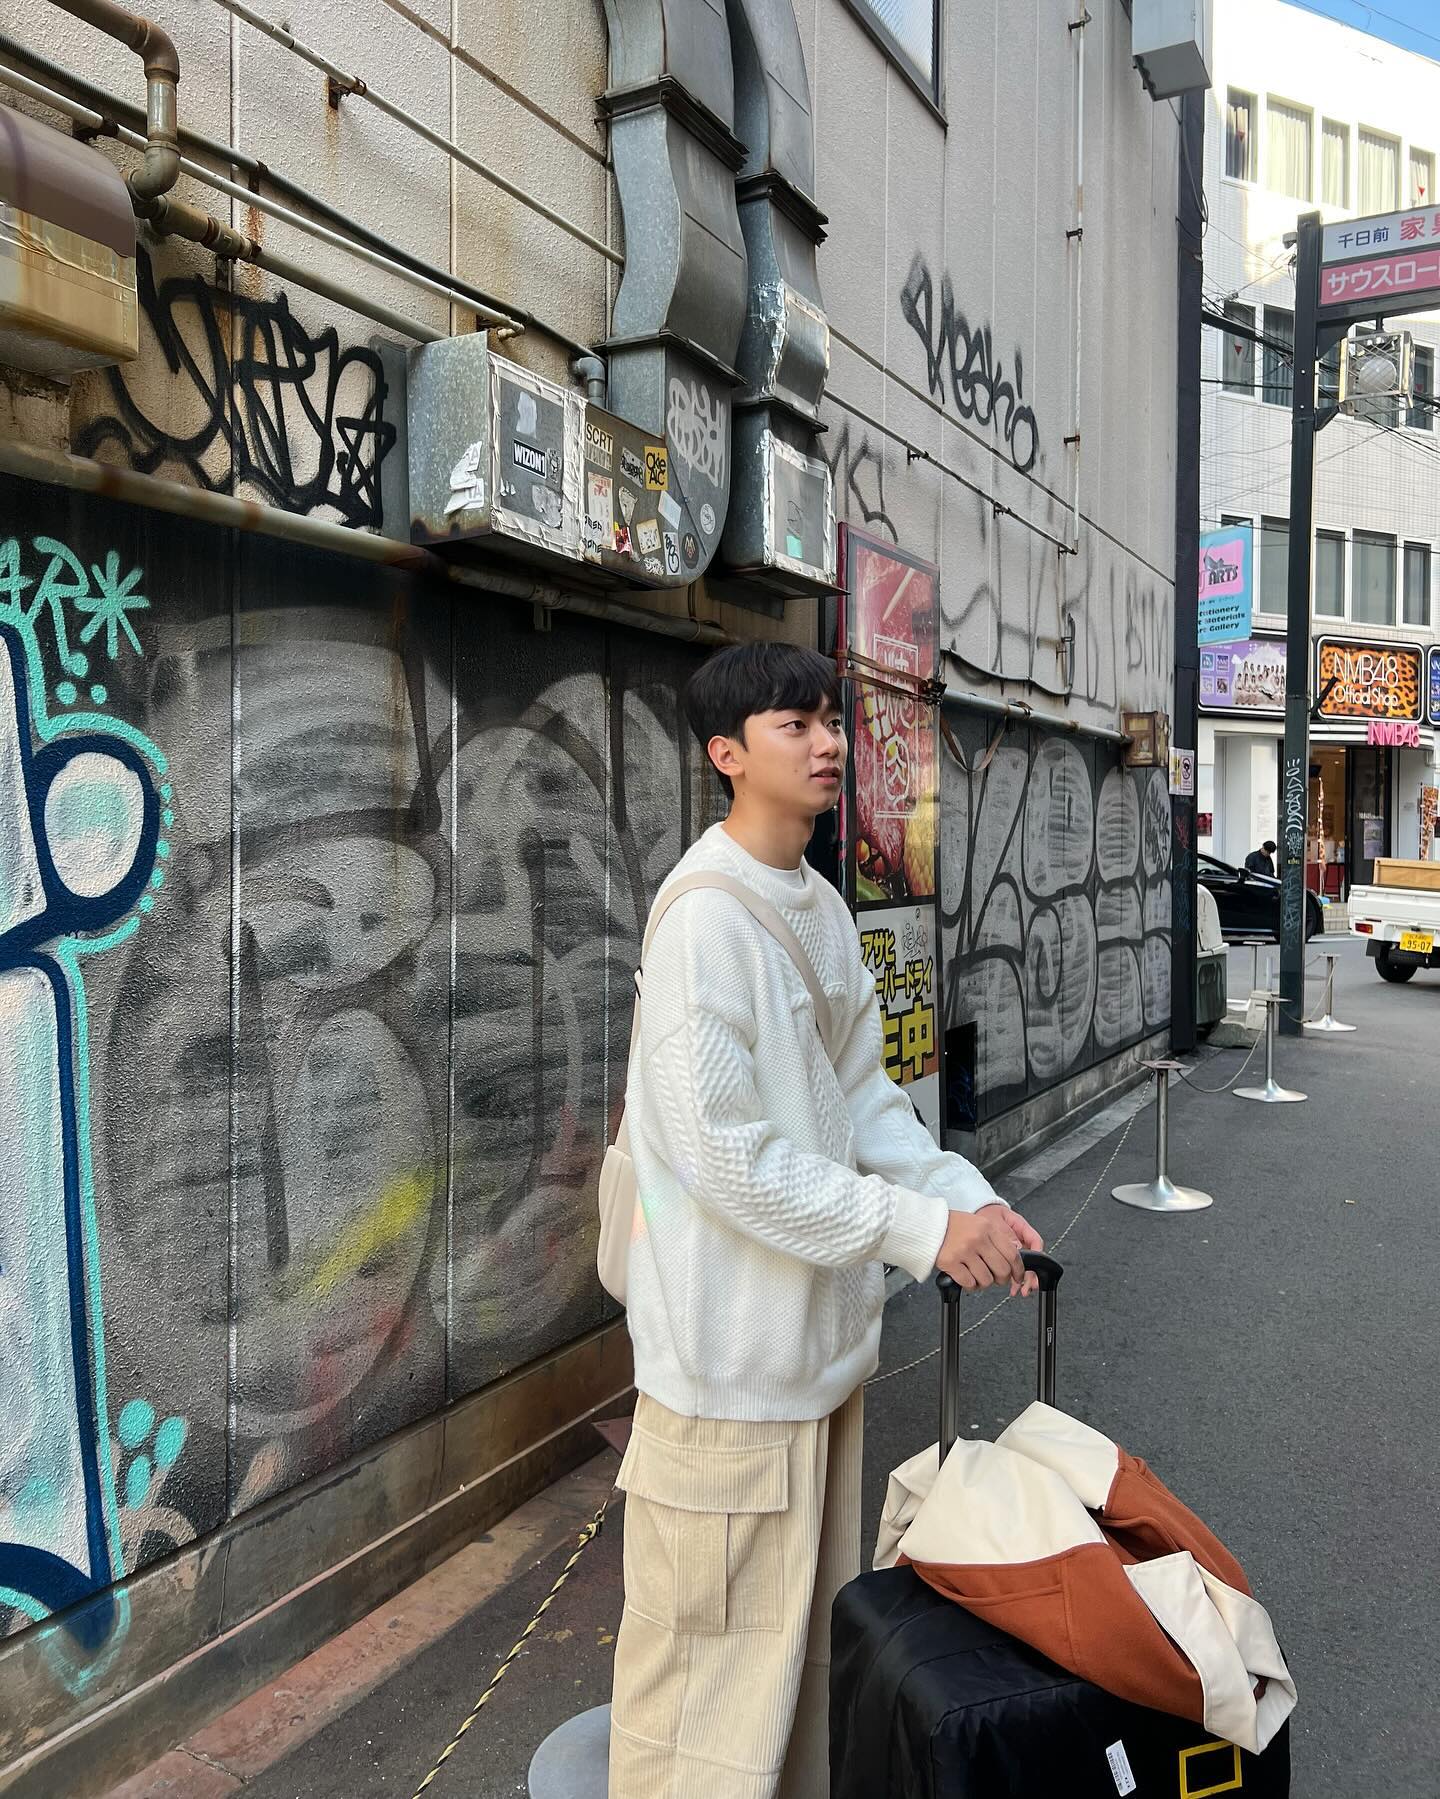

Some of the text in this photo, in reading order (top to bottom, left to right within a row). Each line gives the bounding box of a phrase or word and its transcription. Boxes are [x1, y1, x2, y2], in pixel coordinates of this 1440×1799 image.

[1338, 226, 1389, 249] 千日前
[1327, 256, 1440, 296] サウスロー
[586, 423, 613, 452] SCRT
[1209, 622, 1240, 632] Gallery
[1334, 652, 1398, 687] NMB48
[1333, 684, 1399, 716] Official Shop
[1367, 721, 1420, 748] NMB48
[861, 929, 896, 967] アサヒ
[874, 956, 933, 1003] ーパードライ
